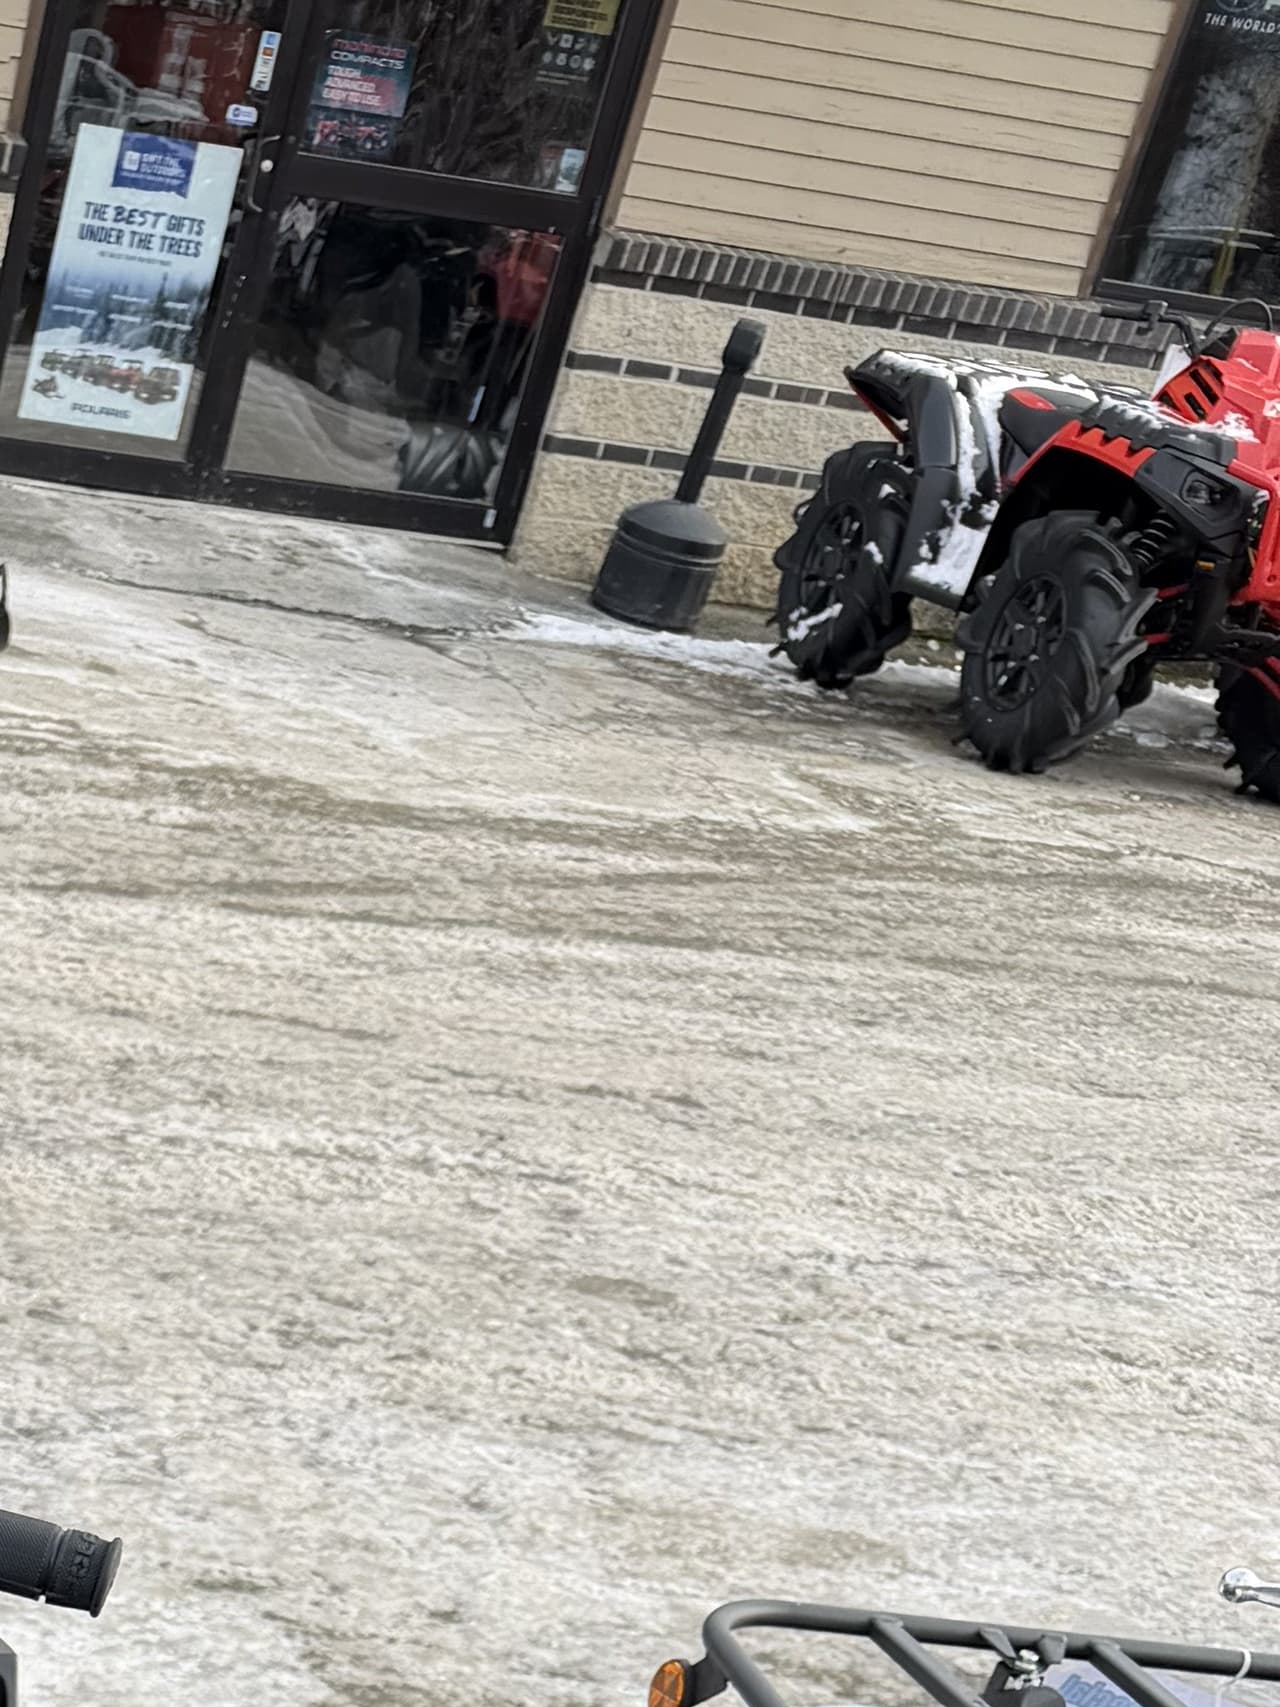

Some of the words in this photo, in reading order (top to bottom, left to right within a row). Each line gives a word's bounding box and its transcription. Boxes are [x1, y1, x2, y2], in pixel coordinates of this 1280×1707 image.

[1204, 12, 1228, 27] THE
[330, 50, 405, 70] COMPACTS
[85, 201, 112, 221] THE
[112, 205, 168, 230] BEST
[166, 214, 206, 237] GIFTS
[77, 223, 125, 247] UNDER
[128, 230, 156, 251] THE
[159, 235, 203, 259] TREES
[70, 402, 133, 420] POLARIS
